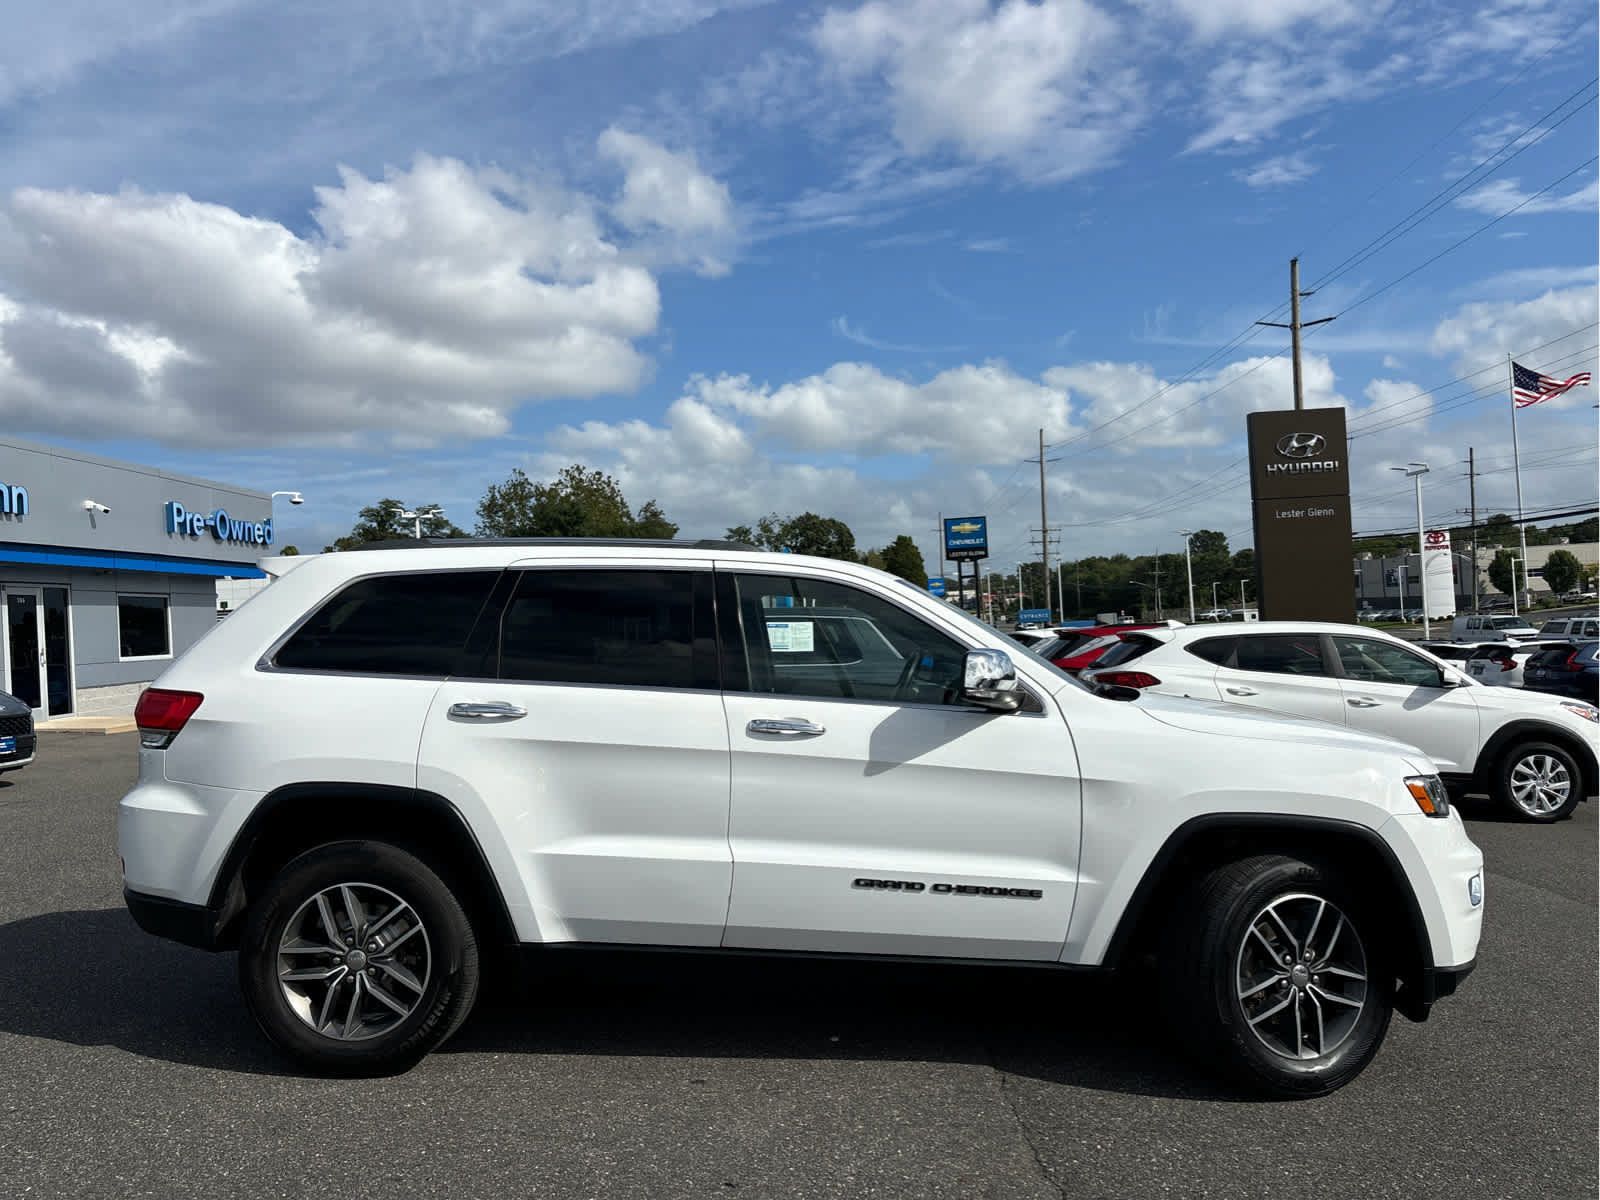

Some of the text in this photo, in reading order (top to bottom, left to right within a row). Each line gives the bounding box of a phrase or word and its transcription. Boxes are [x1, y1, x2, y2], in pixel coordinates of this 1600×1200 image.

[1266, 460, 1339, 473] HYUNDAI
[1276, 507, 1335, 519] Lester Glenn
[166, 501, 273, 545] Pre-Owned
[948, 538, 985, 546] CHEVROLET
[853, 878, 1043, 899] GRAND CHEROKEE
